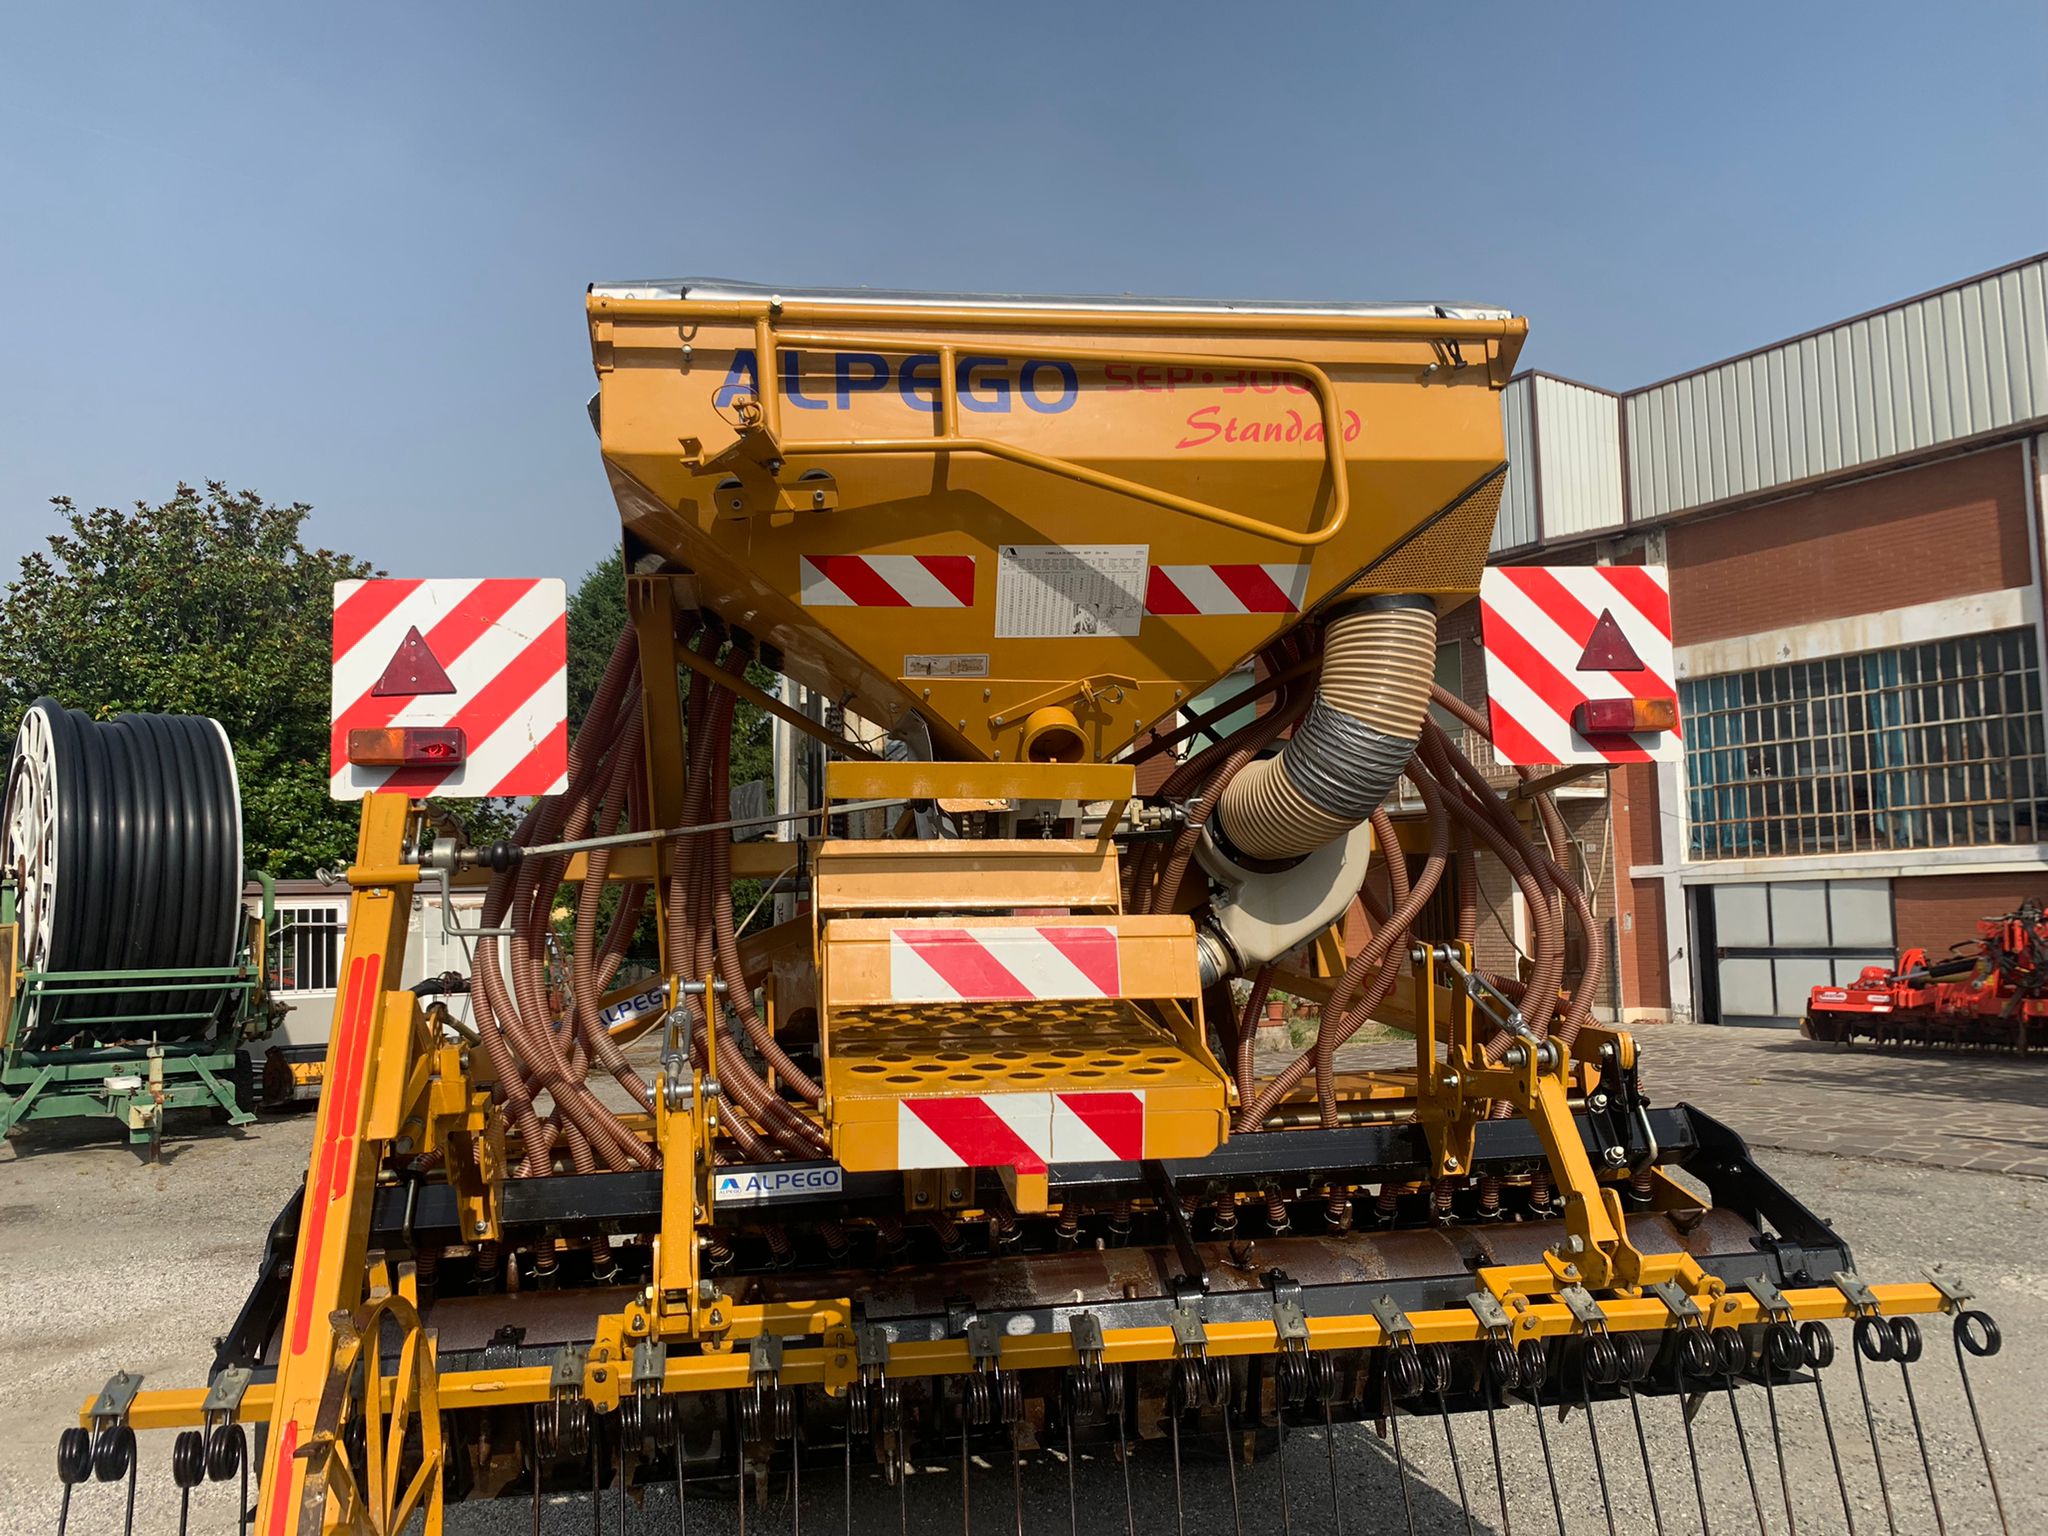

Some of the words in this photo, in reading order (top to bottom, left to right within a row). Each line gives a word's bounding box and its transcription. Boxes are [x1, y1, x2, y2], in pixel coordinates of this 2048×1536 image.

[715, 349, 1080, 415] ALPEGO
[1175, 405, 1362, 450] Standad
[746, 1170, 839, 1192] ALPEGO
